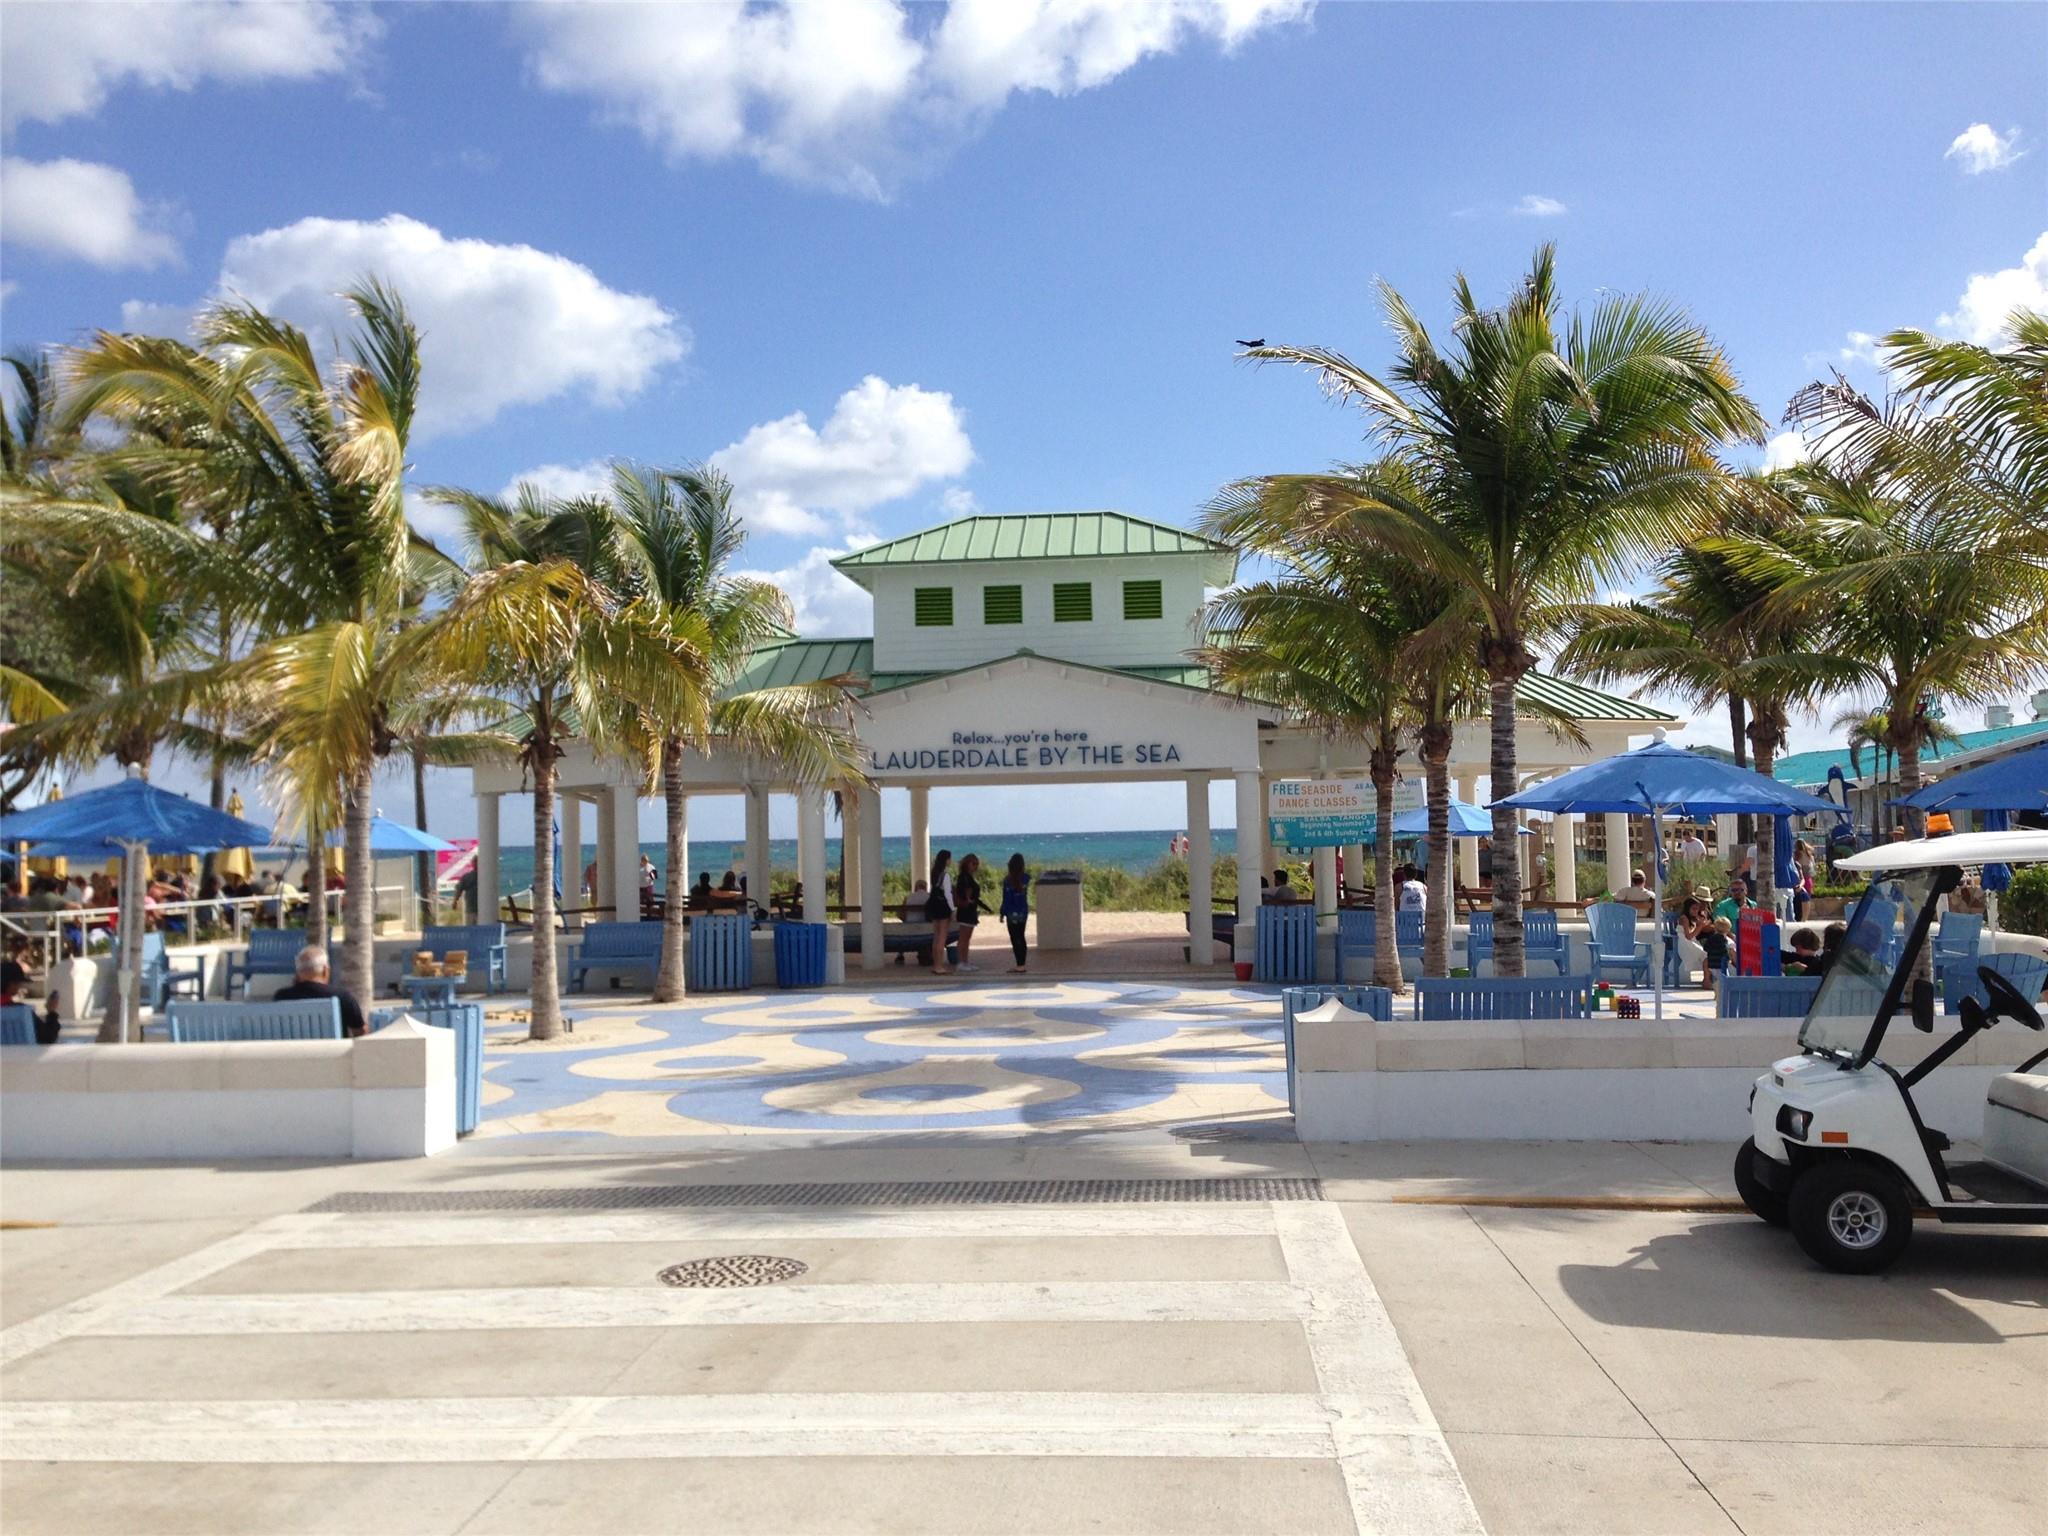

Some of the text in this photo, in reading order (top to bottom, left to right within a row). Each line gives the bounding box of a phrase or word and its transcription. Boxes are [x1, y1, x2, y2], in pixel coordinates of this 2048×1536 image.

[952, 730, 1088, 746] Relax...you're here
[872, 744, 1181, 770] LAUDERDALE BY THE SEA
[1272, 784, 1343, 796] FREE SEASIDE
[1278, 796, 1358, 808] DANCE CLASSES
[1299, 822, 1332, 830] Beginning
[1332, 820, 1364, 828] November
[1335, 829, 1359, 837] Sunday
